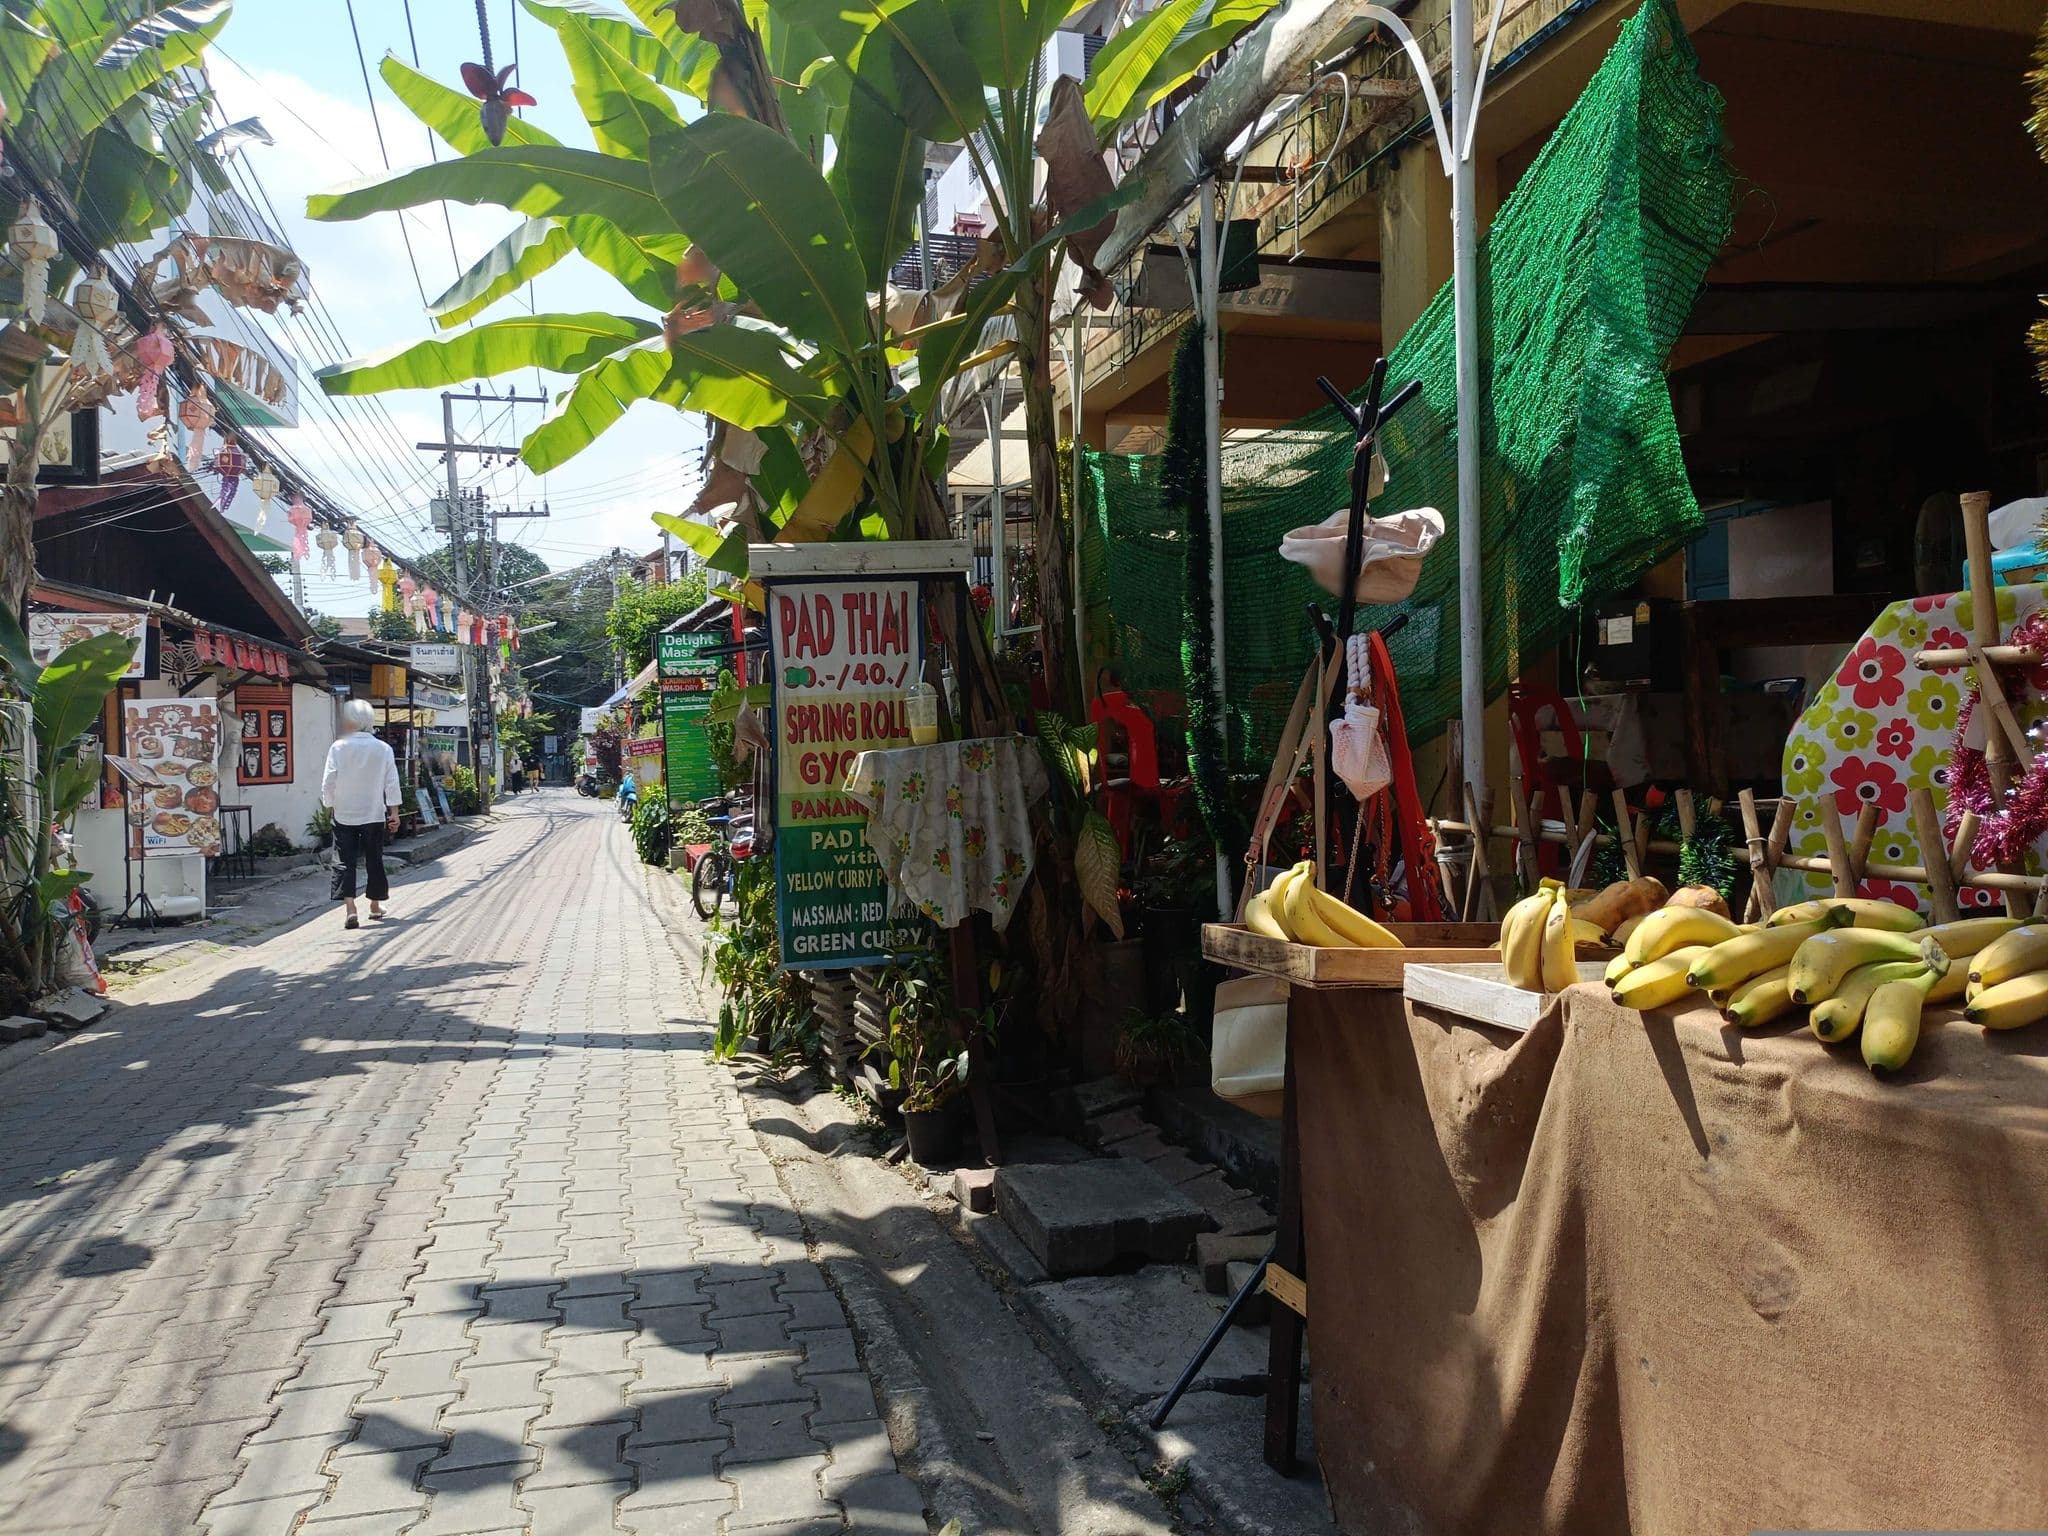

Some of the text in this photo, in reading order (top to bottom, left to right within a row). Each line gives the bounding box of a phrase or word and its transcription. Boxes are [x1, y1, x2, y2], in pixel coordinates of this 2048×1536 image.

[779, 590, 909, 660] PAD THAI
[786, 700, 909, 744] SPRING ROLL
[428, 743, 455, 751] PARK
[811, 829, 853, 850] PAD
[833, 851, 877, 865] with
[786, 869, 834, 894] YELLOW
[837, 867, 873, 890] CURRY
[791, 903, 852, 928] MASSMAN
[861, 902, 883, 922] RED
[793, 928, 923, 954] GREEN CURRY
